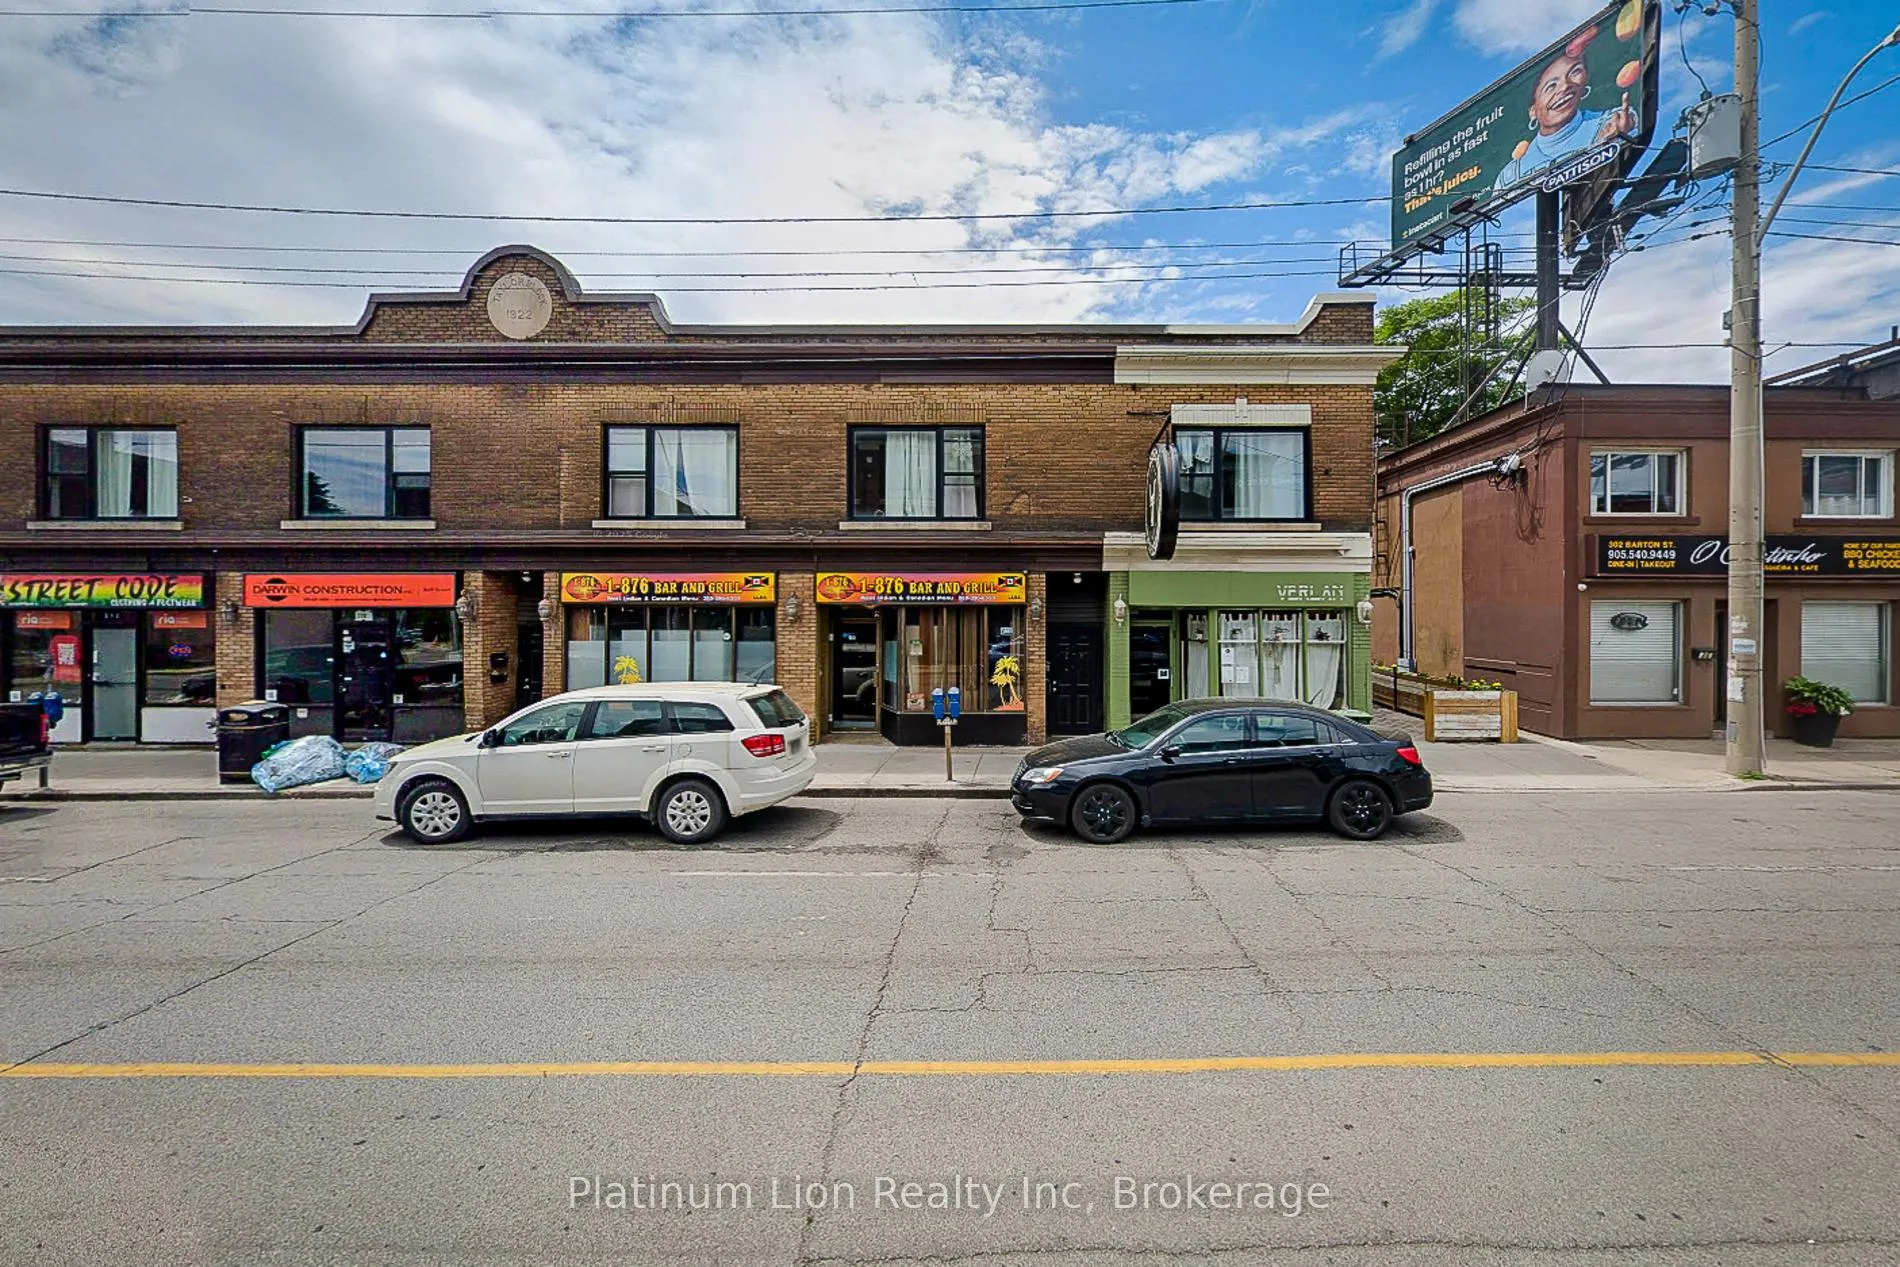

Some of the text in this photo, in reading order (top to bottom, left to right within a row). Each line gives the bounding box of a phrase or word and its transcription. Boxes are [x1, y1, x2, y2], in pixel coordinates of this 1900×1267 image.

[1404, 105, 1504, 176] Refilling the fruit
[1404, 129, 1488, 189] bowl in as fast
[1549, 147, 1614, 188] PATTISON
[1404, 187, 1418, 202] as
[1425, 169, 1445, 191] hr?
[1404, 187, 1443, 214] That's
[1443, 165, 1483, 194] juicy.
[1608, 541, 1677, 549] 302 BARTON ST.
[1843, 549, 1863, 559] BBQ
[1607, 550, 1677, 560] 905.540.9449
[1640, 560, 1676, 568] TAKEOUT
[9, 576, 178, 601] STREET CODE
[252, 585, 300, 594] DARWIN
[303, 585, 403, 594] CONSTRUCTION
[607, 576, 742, 594] 1-876 BAR AND GRILL
[860, 576, 997, 594] 1-876 BAR AND GRILL
[1276, 585, 1344, 601] VERLAN
